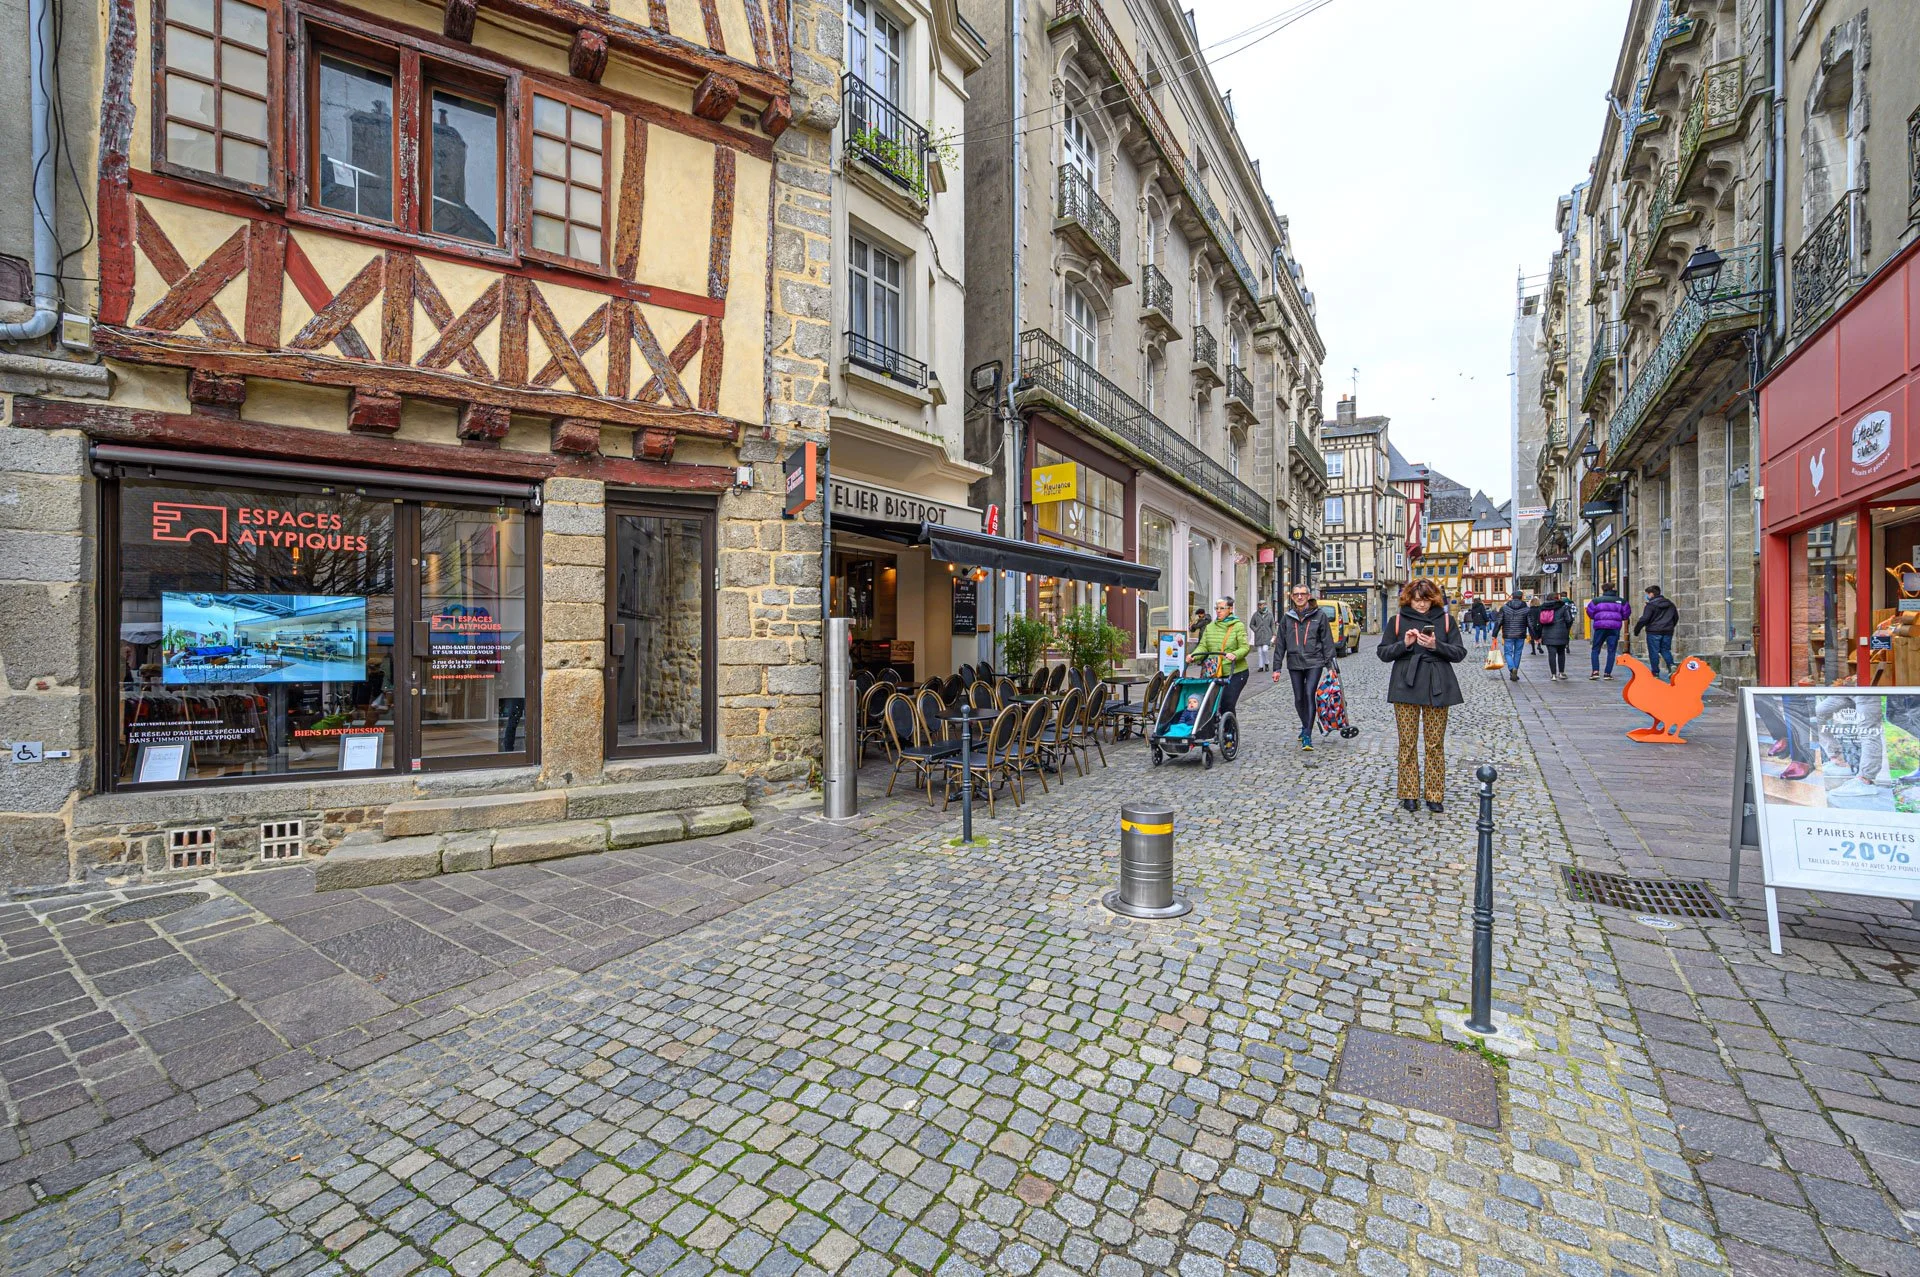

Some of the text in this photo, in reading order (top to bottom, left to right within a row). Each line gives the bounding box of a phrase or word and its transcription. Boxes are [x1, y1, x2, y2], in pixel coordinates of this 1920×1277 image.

[829, 483, 878, 512] ELIER
[885, 496, 947, 524] BISTROT
[238, 507, 343, 530] ESPACES
[237, 529, 368, 552] ATYPIQUES
[141, 730, 171, 738] RÉSEAU
[173, 729, 213, 737] D'AGENCES
[214, 727, 256, 735] SPÉCIALISÉ
[294, 727, 386, 737] BIENS D'EXPRESSION
[1821, 724, 1881, 737] Finsbury
[152, 735, 205, 743] L'IMMOBILIER
[205, 733, 242, 741] ATYPIQUE
[1806, 827, 1916, 843] 2 PAIRES ACHETÉES
[1808, 857, 1830, 865] TAILLES
